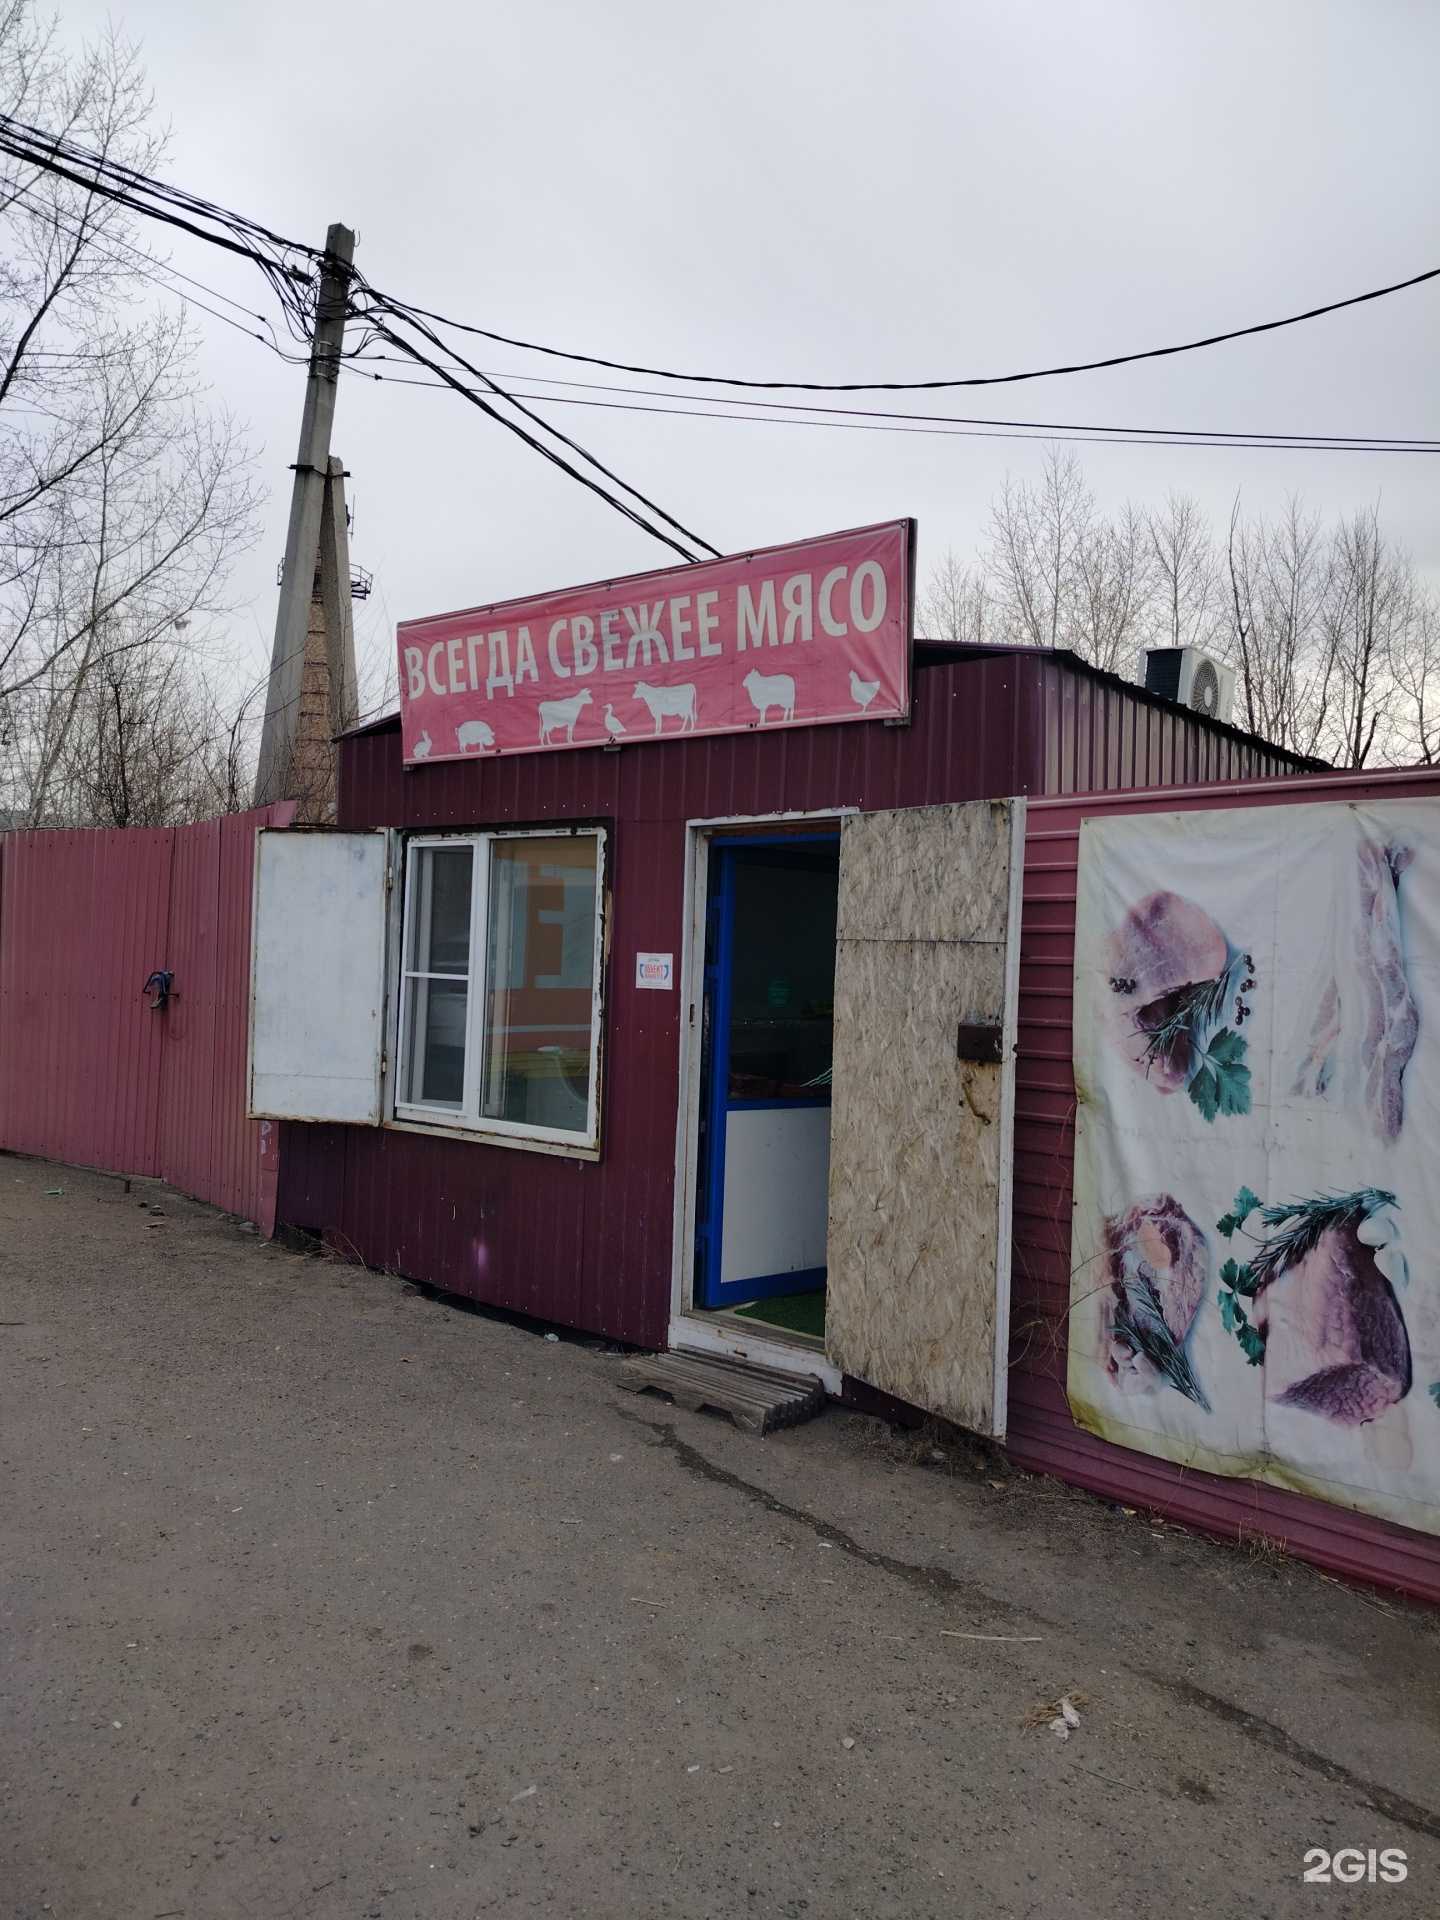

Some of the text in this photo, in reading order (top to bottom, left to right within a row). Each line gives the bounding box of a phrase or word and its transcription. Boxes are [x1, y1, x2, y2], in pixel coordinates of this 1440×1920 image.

[404, 560, 888, 700] ВСЕГДА СВЕЖЕЕ МЯСО
